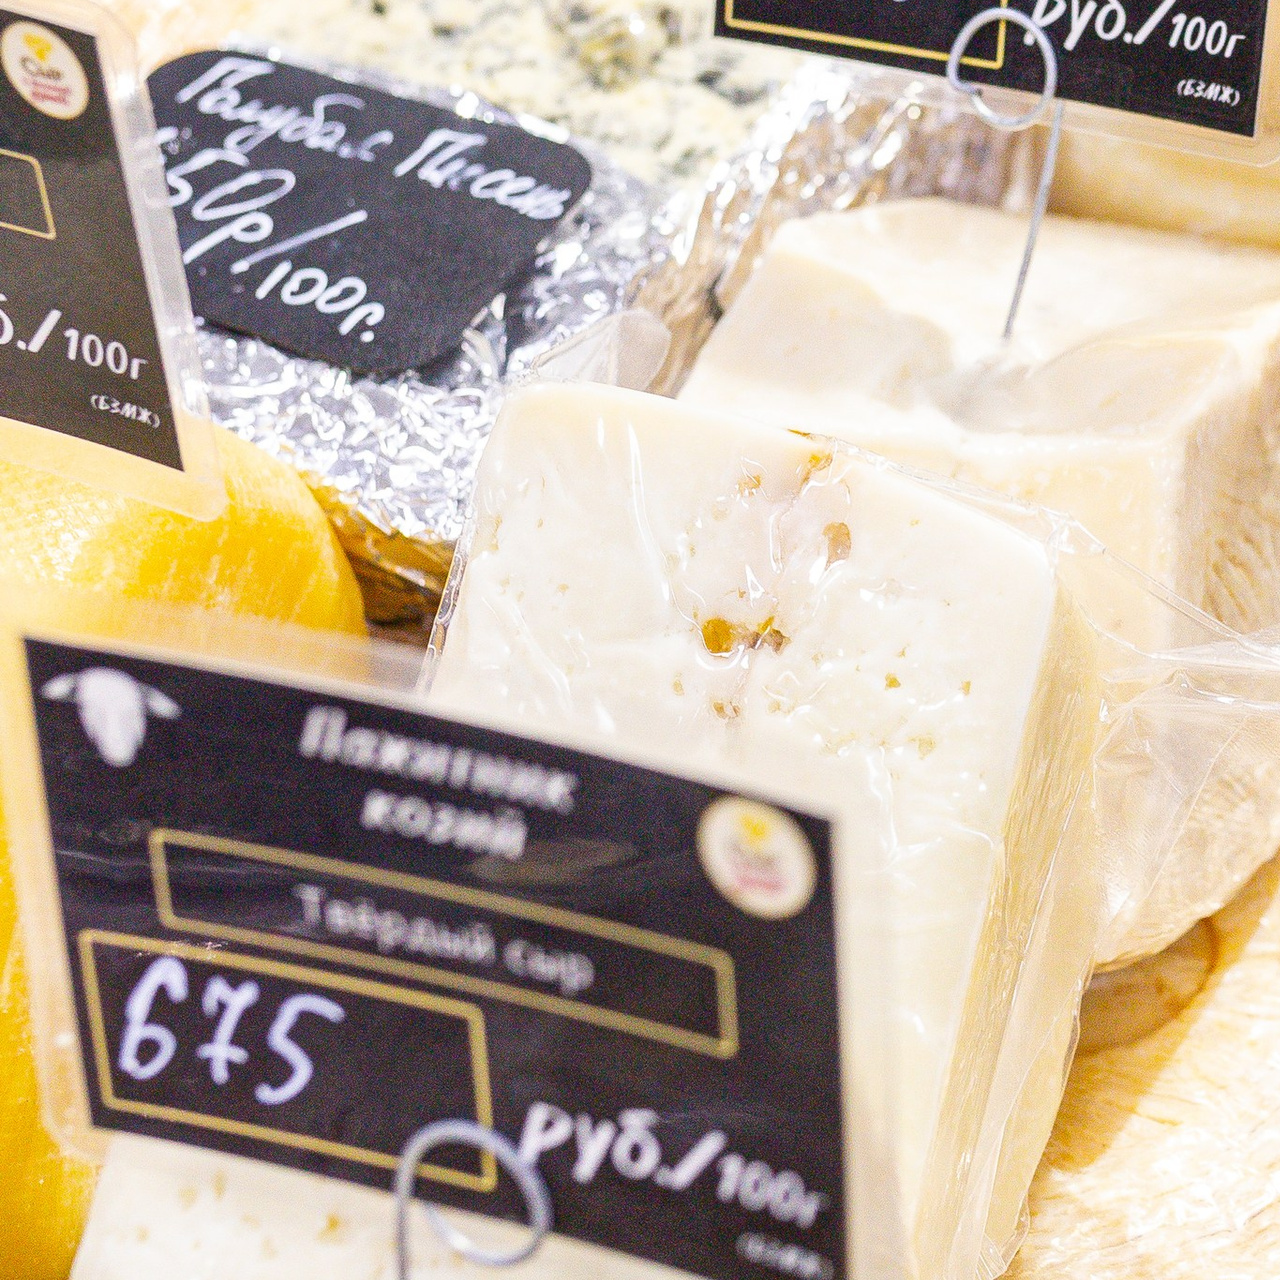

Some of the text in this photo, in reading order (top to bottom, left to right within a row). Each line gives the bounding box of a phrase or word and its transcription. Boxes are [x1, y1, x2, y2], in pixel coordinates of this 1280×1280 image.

[1176, 78, 1241, 107] (БЗМЖ)
[90, 394, 161, 429] (БЗМЖ)
[504, 937, 595, 997] сыр
[118, 956, 346, 1106] 675
